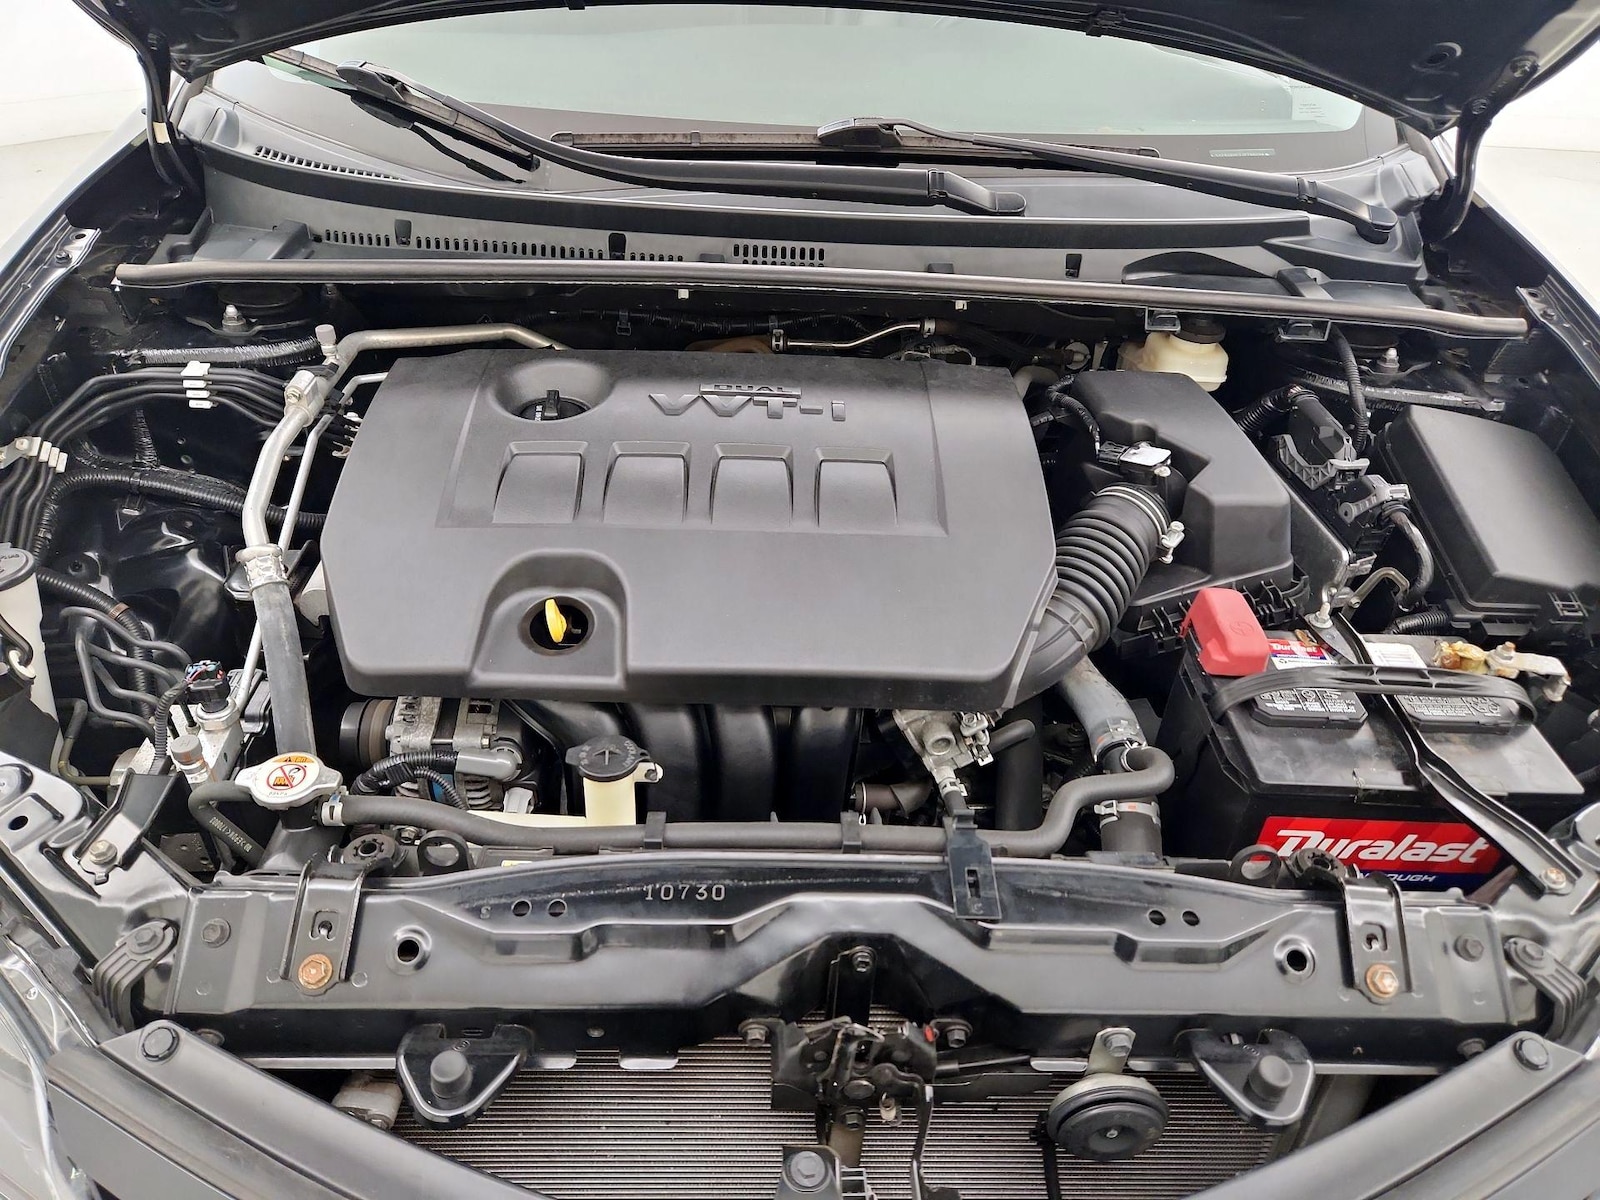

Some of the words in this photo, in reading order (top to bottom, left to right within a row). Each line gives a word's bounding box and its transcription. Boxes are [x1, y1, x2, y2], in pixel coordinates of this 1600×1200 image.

[713, 384, 793, 394] DUAL
[1277, 829, 1489, 864] Duralast
[1385, 873, 1437, 882] OUGH
[645, 884, 726, 900] 10730
